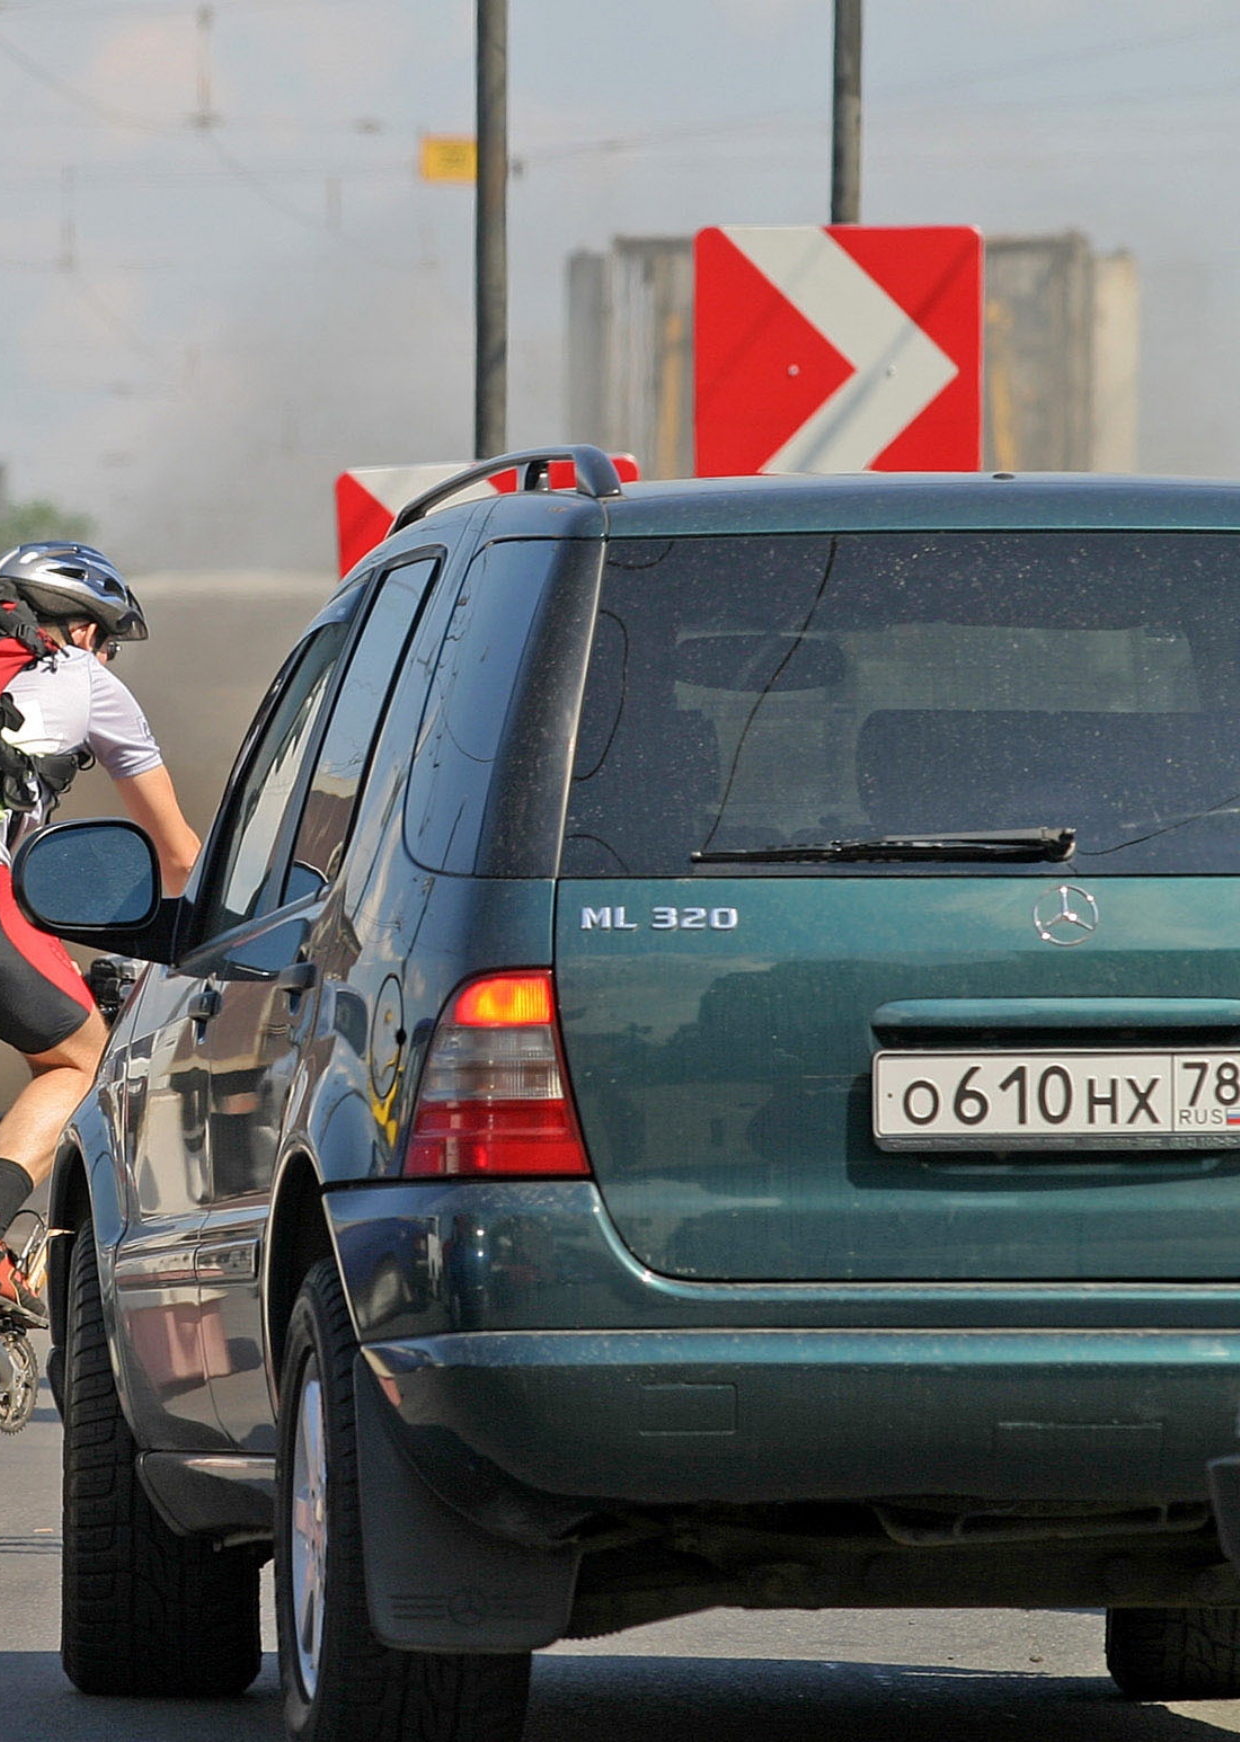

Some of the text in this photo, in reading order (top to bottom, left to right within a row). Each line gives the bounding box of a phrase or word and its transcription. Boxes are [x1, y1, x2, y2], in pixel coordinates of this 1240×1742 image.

[581, 906, 739, 930] ML 320
[1181, 1061, 1240, 1108] 78
[1178, 1109, 1224, 1126] RUS
